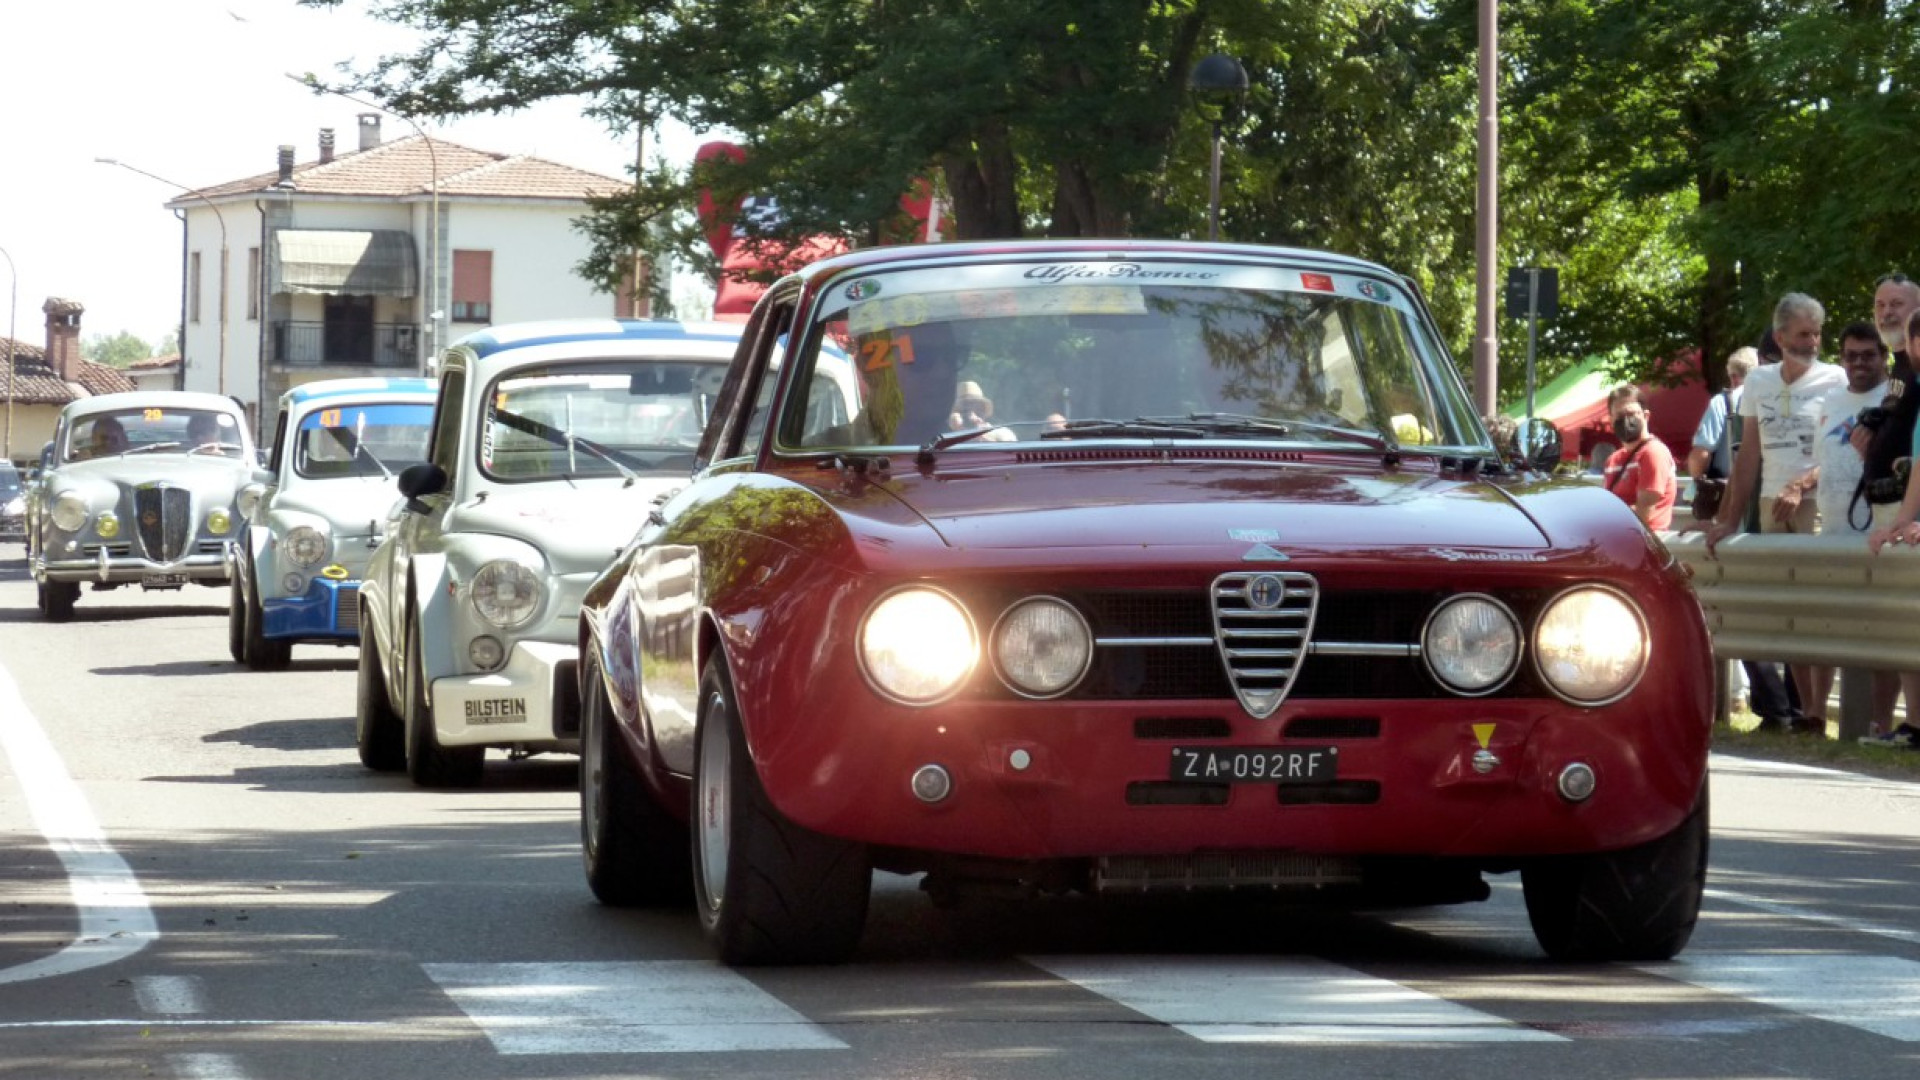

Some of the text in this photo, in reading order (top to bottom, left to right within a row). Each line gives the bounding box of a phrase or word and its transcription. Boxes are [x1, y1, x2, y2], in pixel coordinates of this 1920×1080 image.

[1023, 263, 1220, 284] Alfa Romeo
[862, 334, 916, 371] 21
[464, 698, 526, 717] BILSTEIN
[1184, 752, 1323, 778] ZA 092RF
